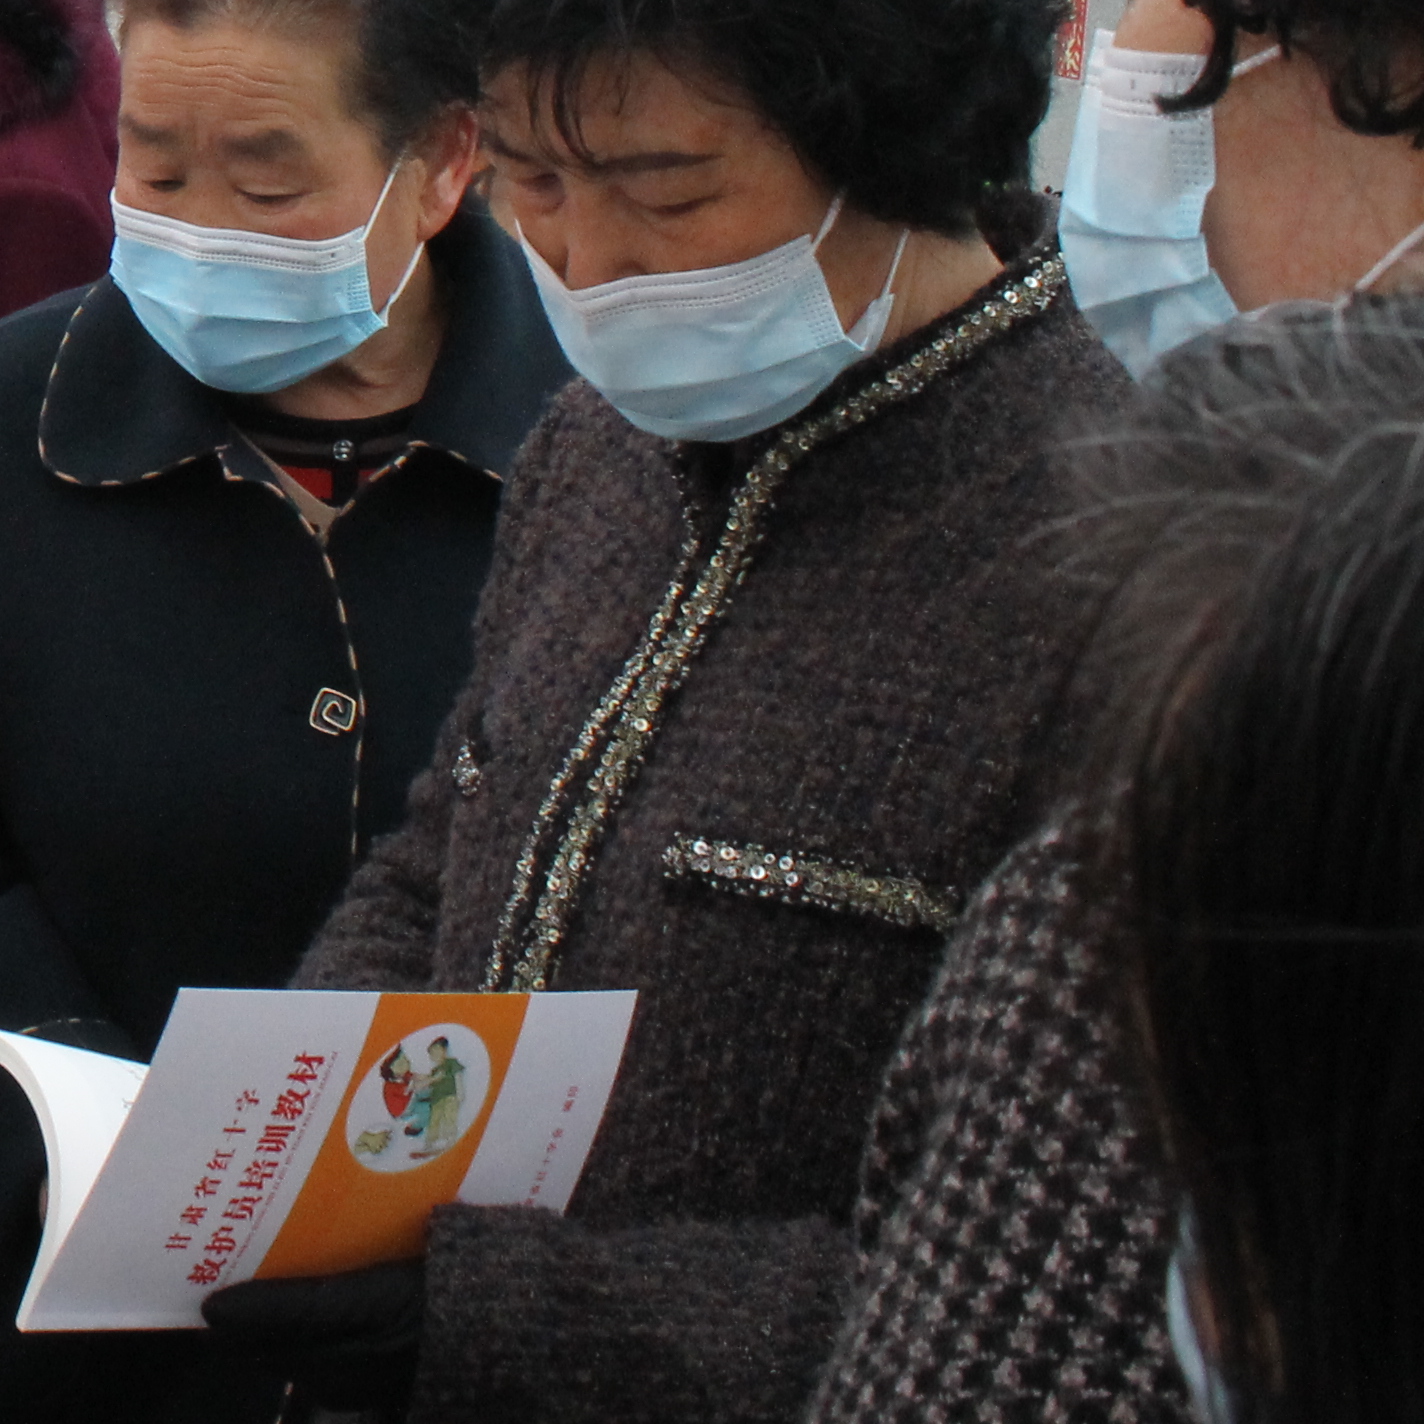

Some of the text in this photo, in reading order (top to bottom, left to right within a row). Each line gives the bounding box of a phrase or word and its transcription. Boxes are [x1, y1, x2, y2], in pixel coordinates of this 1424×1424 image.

[164, 1087, 261, 1253] 甘肃省红十字
[186, 1050, 328, 1286] 救护员培训教材
